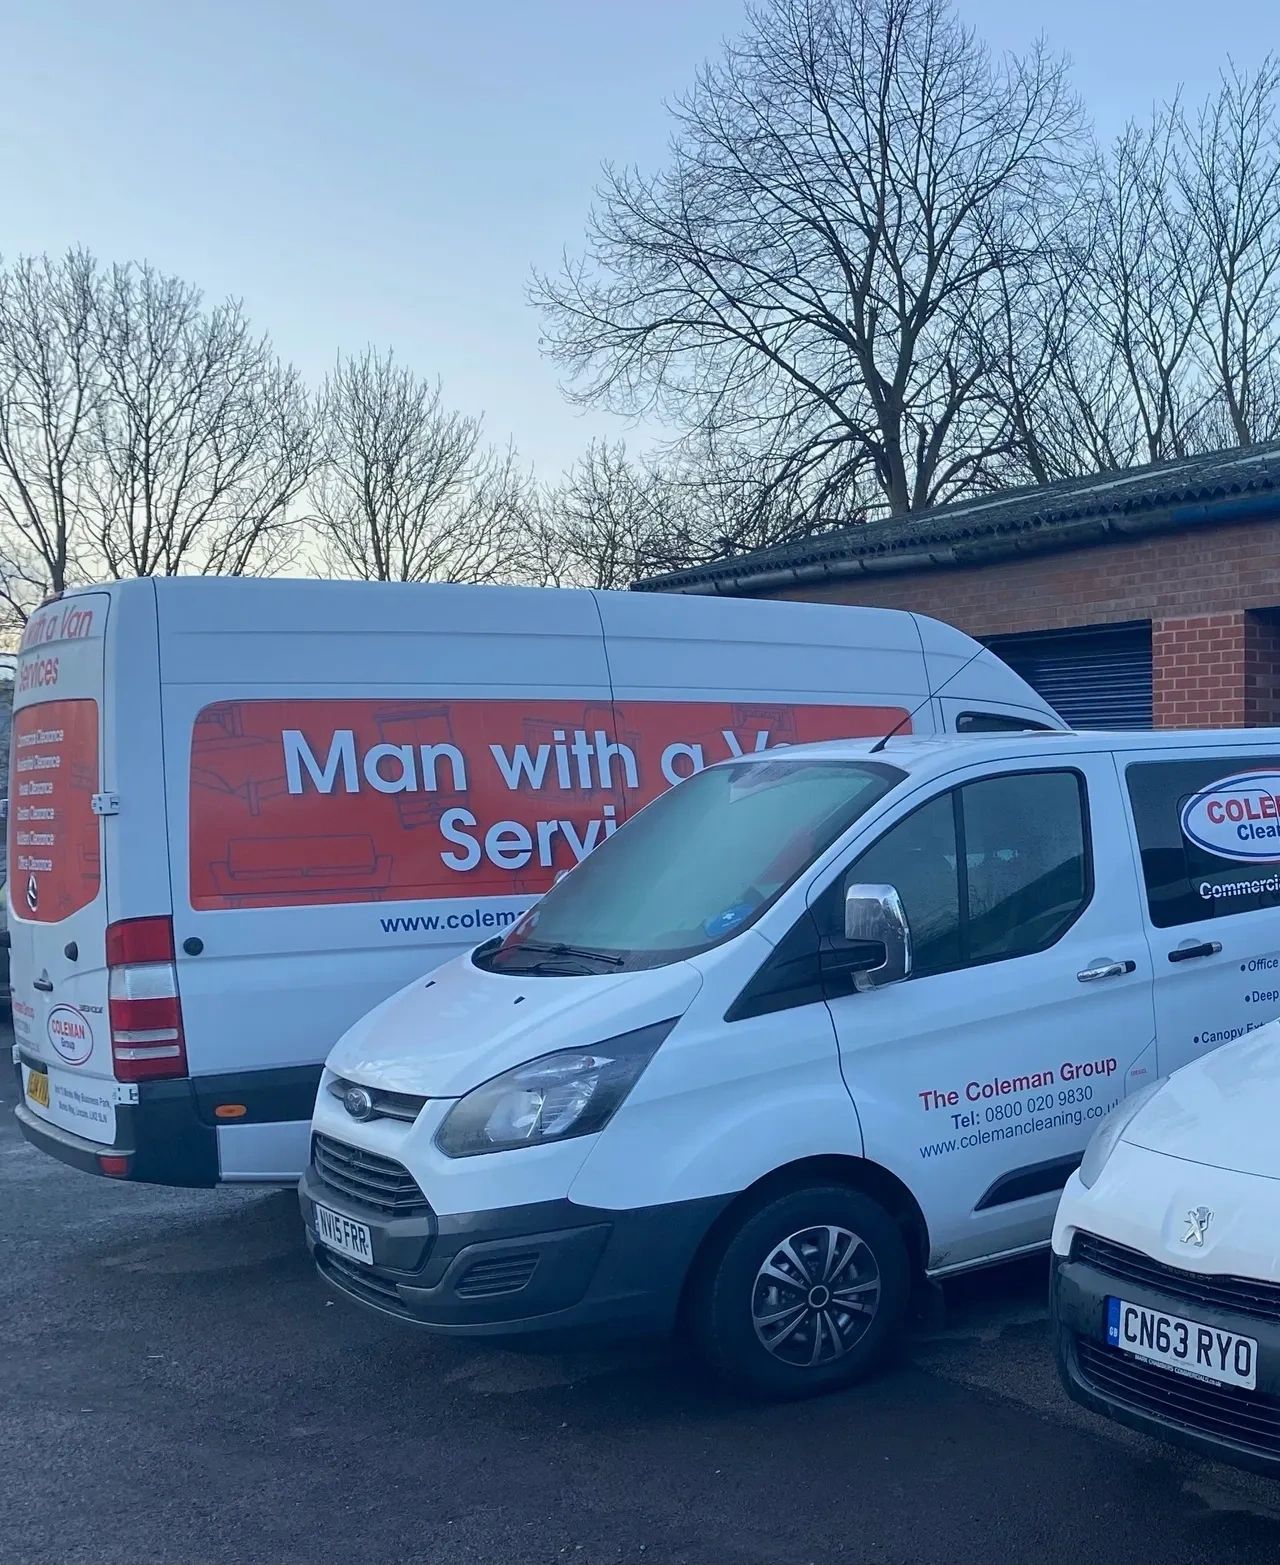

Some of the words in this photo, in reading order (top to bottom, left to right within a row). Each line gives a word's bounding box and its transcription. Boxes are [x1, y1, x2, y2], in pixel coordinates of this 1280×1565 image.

[61, 605, 93, 638] Van
[281, 729, 468, 795] Man
[489, 729, 639, 791] with
[661, 742, 705, 786] a
[1248, 958, 1279, 972] Office
[1252, 990, 1279, 1002] Deep
[51, 1019, 85, 1040] COLEMAN
[1201, 1027, 1244, 1044] Canopy
[61, 1037, 75, 1052] Group
[919, 1090, 960, 1111] The
[965, 1069, 1054, 1100] Coleman
[1060, 1057, 1117, 1082] Group
[951, 1112, 980, 1130] Tel:
[985, 1101, 1022, 1123] 0800
[1027, 1094, 1054, 1113] 020
[1058, 1085, 1093, 1106] 9830
[319, 1208, 342, 1244] NV15
[343, 1221, 368, 1255] FRR
[1109, 1325, 1118, 1338] GB
[1124, 1307, 1189, 1359] CN63
[1196, 1327, 1251, 1377] RYO
